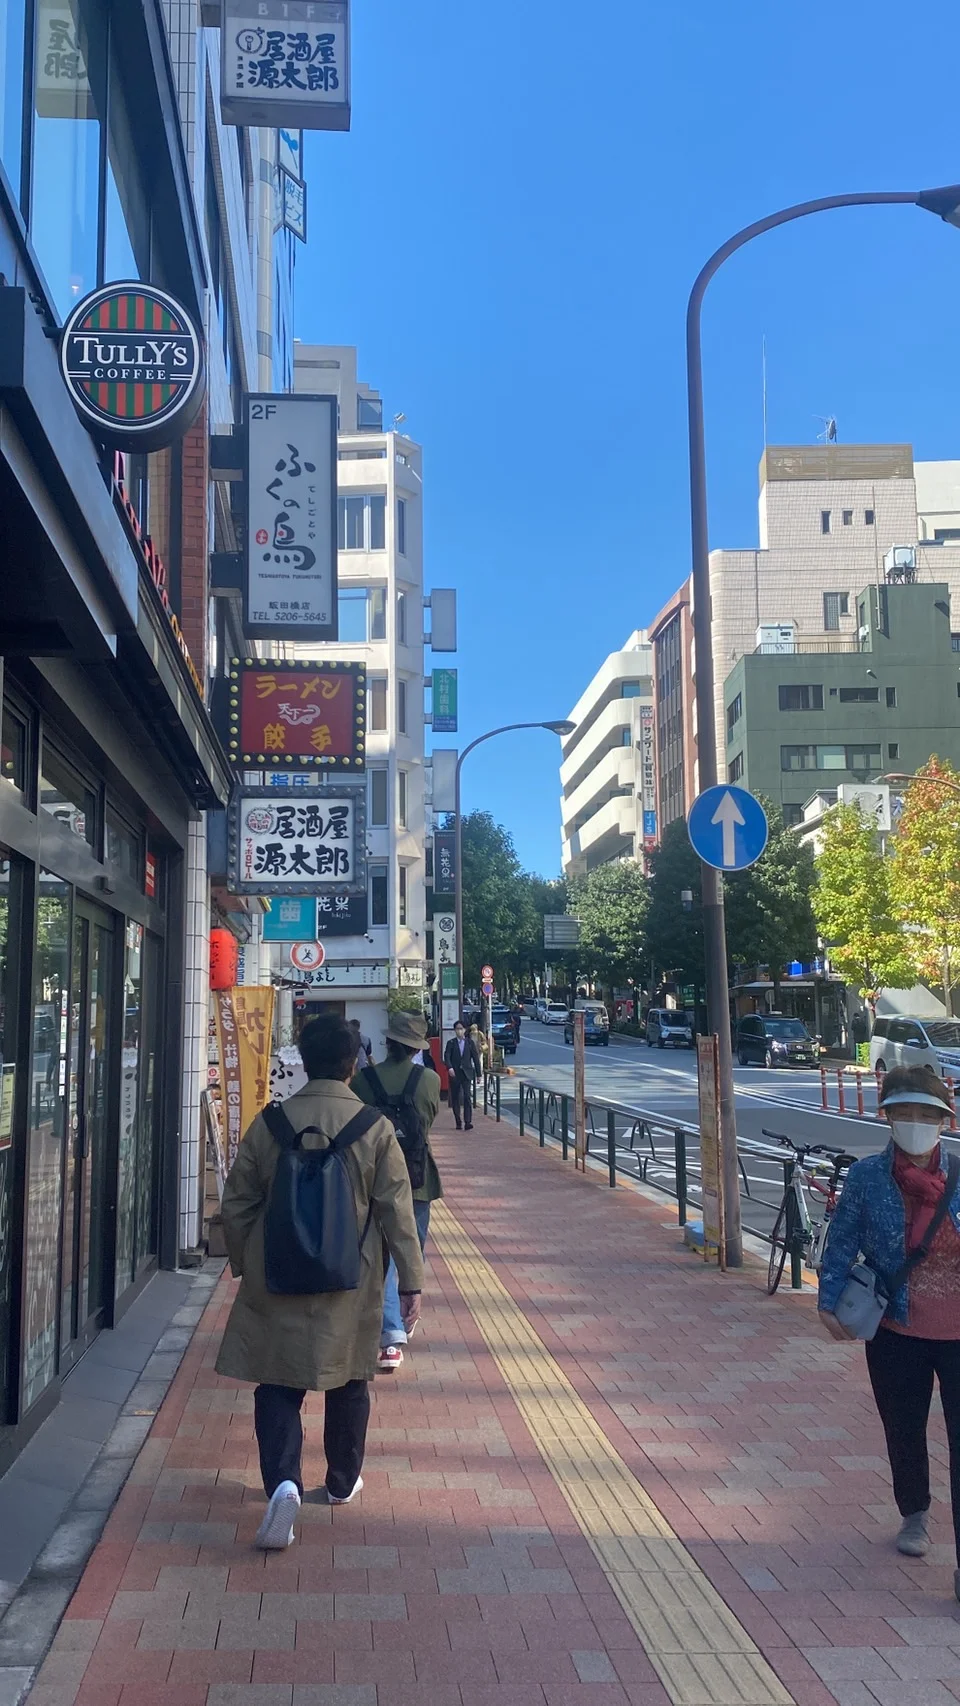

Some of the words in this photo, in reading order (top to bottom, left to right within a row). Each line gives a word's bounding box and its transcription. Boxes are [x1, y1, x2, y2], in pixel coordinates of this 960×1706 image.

[259, 31, 336, 64] 居酒屋
[247, 59, 339, 92] 源太郎
[73, 337, 188, 366] TULLY'S
[94, 368, 166, 380] COFFEE
[251, 404, 277, 420] 2F
[263, 443, 316, 571] ふくの鳥
[308, 485, 316, 540] てしごとや
[253, 611, 271, 620] TEL
[274, 612, 327, 621] 5206-5645
[255, 675, 341, 699] ラーメン
[263, 723, 333, 752] 餃子
[270, 773, 311, 786] 指圧
[270, 805, 350, 839] 居酒屋
[244, 838, 253, 879] サッポロビール
[254, 843, 350, 877] 源太郎
